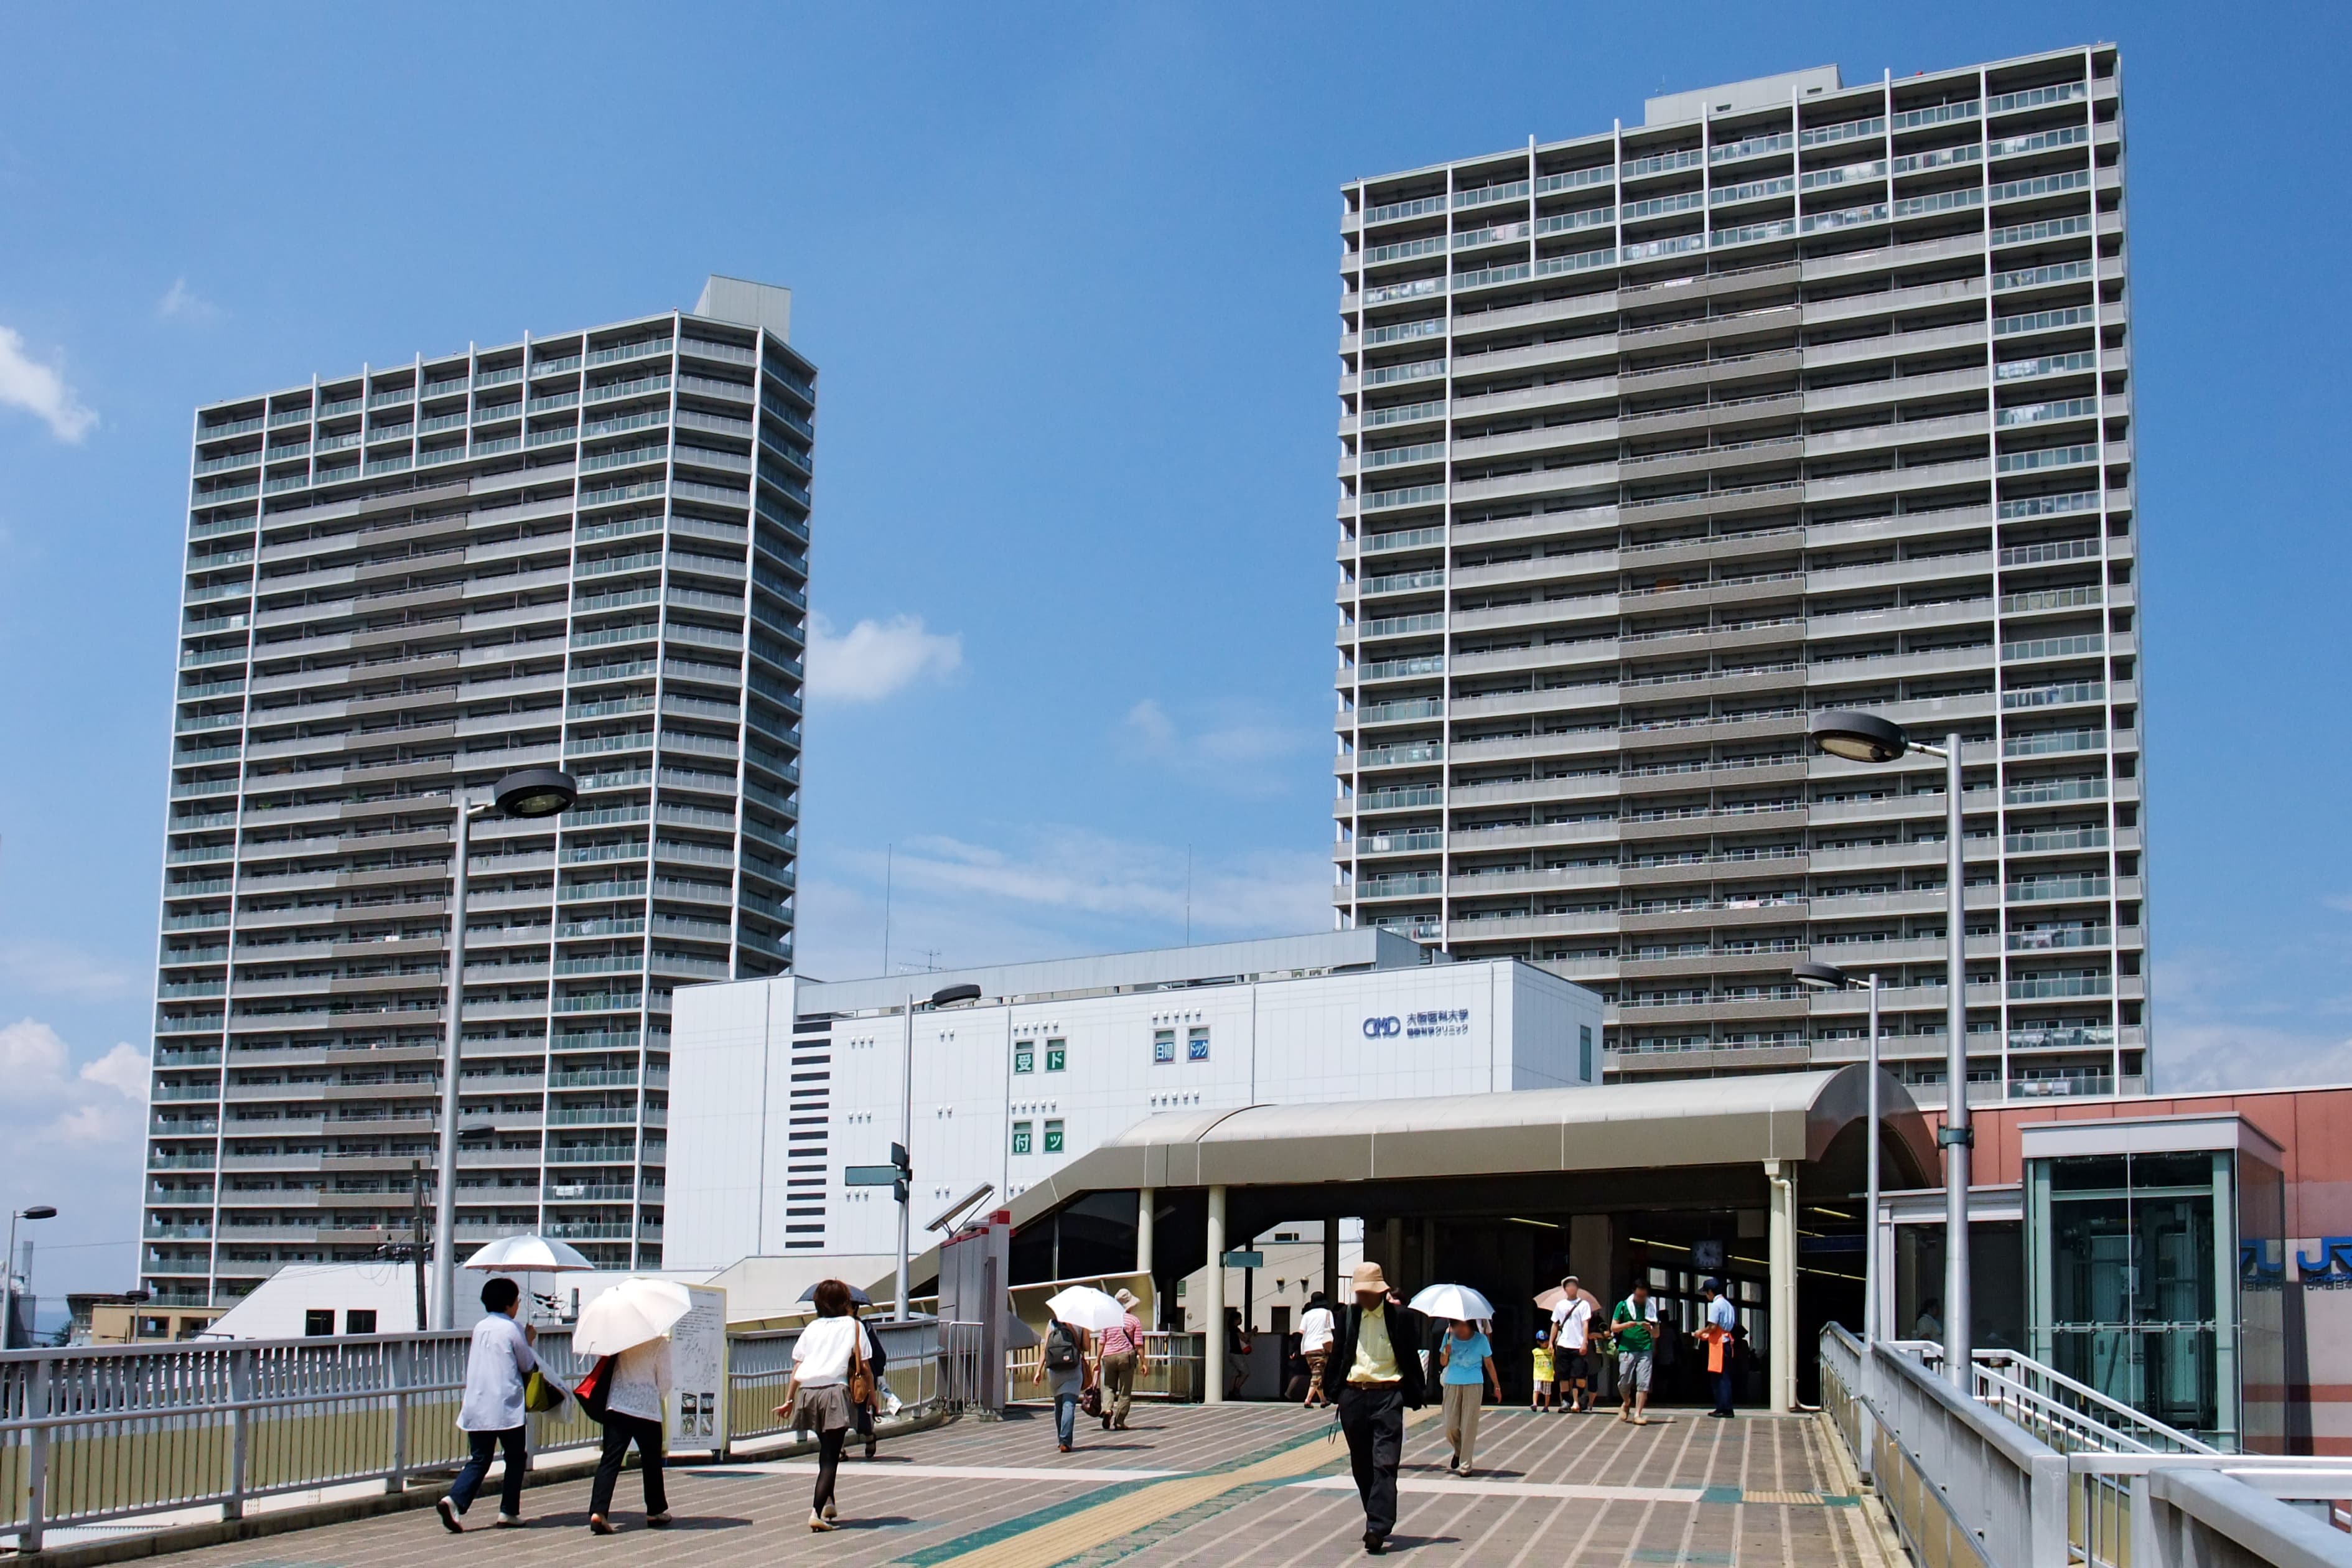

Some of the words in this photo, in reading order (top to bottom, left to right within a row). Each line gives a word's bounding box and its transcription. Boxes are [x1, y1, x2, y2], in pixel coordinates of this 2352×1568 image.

[1156, 1043, 1173, 1059] 日帰
[1190, 1041, 1208, 1057] ドック
